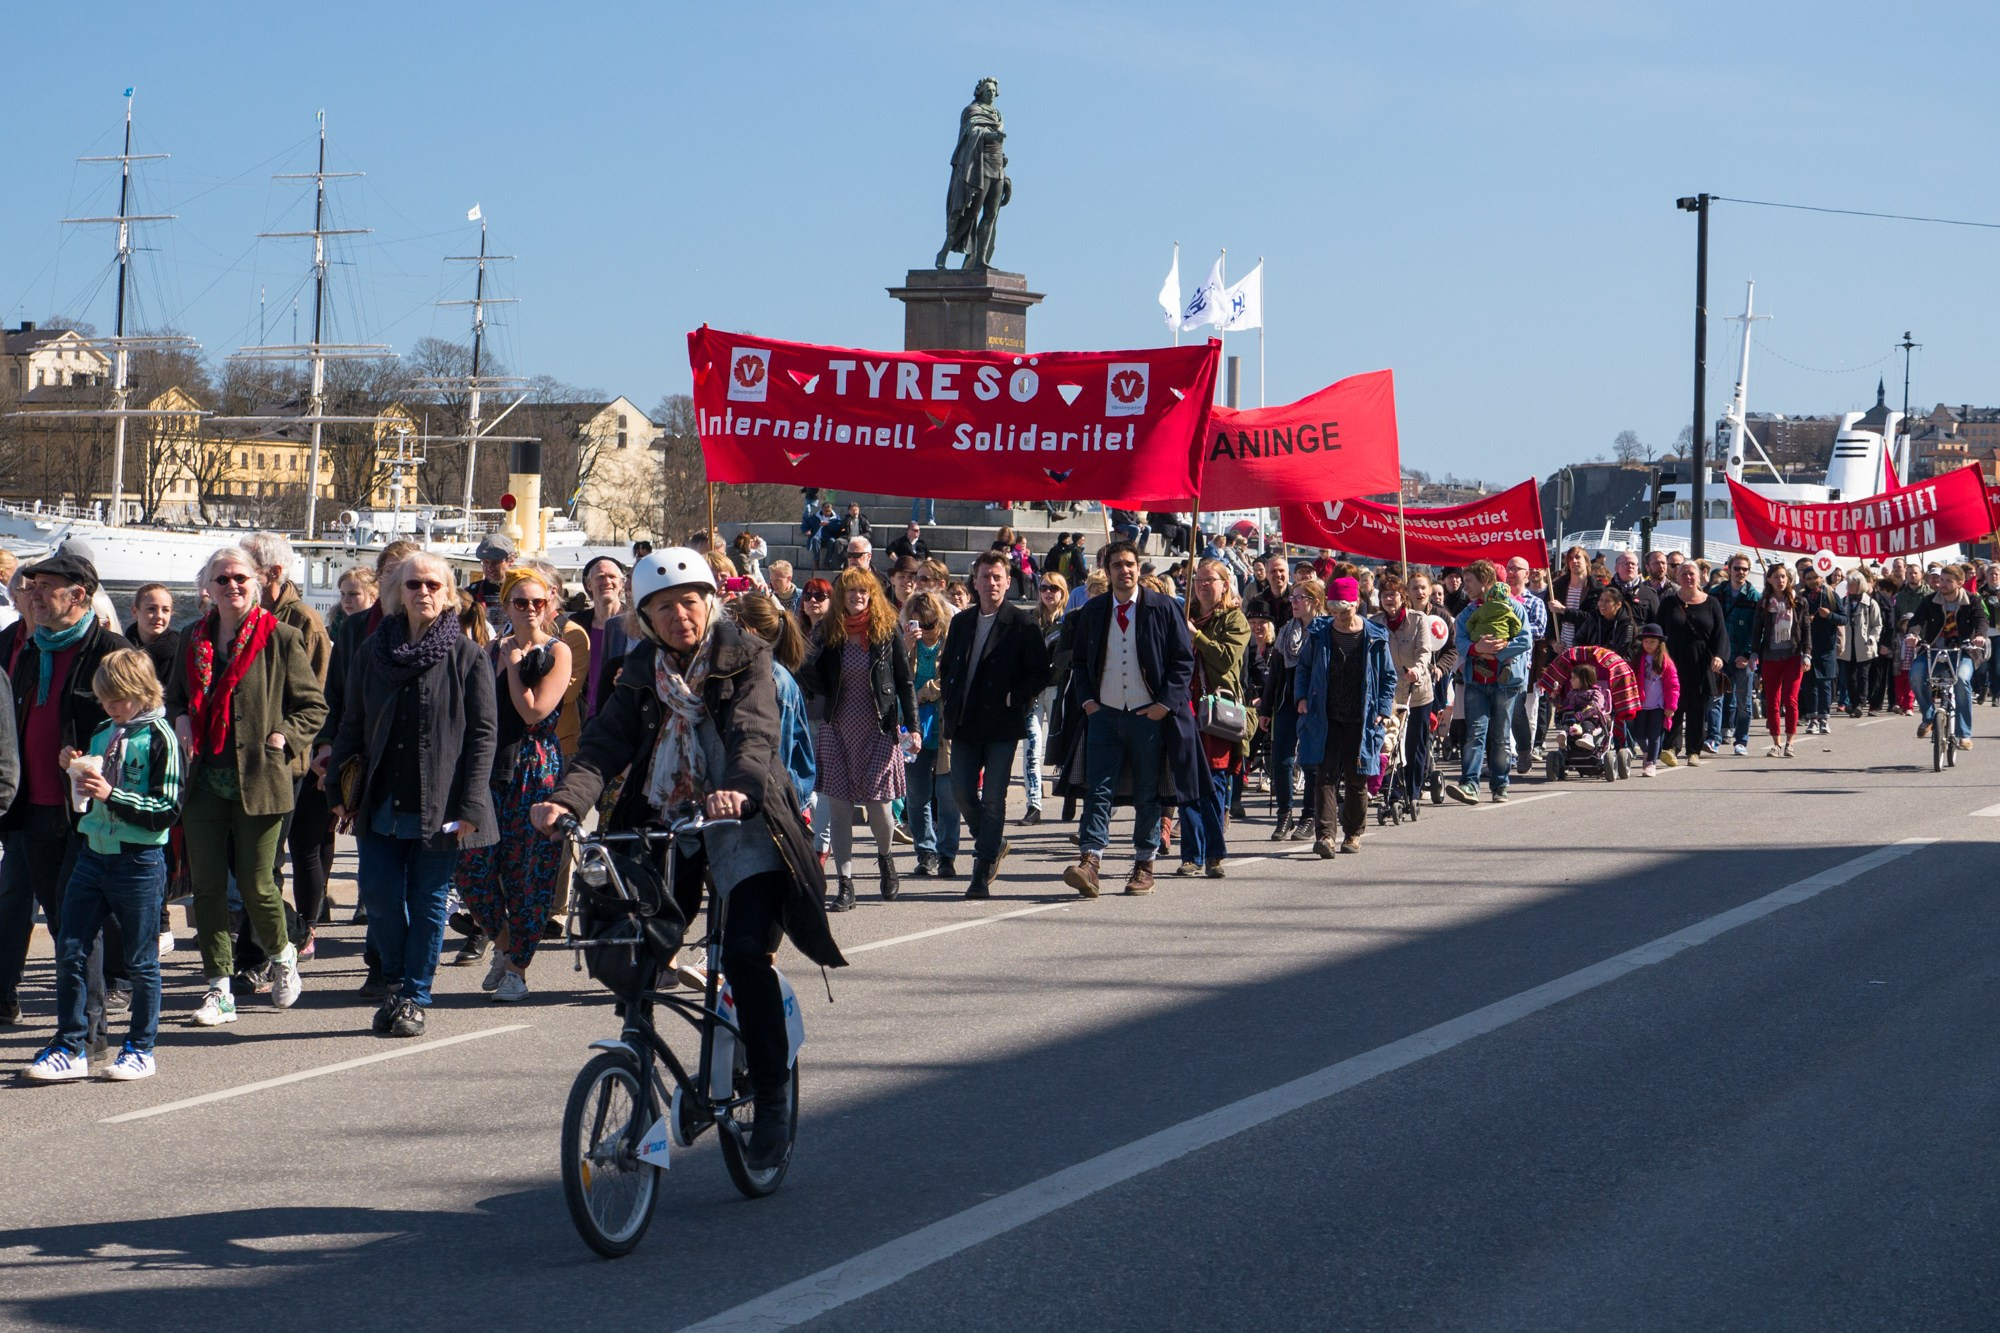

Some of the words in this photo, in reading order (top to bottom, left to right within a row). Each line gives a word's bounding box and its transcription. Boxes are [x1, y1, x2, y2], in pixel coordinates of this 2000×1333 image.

[742, 363, 758, 381] V
[828, 356, 1040, 403] TYRESÖ
[1120, 378, 1137, 397] V
[699, 406, 916, 450] Internationell
[951, 422, 1135, 452] Solidaritet
[1204, 421, 1342, 462] ANINGE
[1380, 509, 1509, 530] Vänsterpartiet
[1773, 518, 1937, 556] KUNGSOLMEN
[1820, 560, 1830, 570] V
[1435, 625, 1445, 636] V
